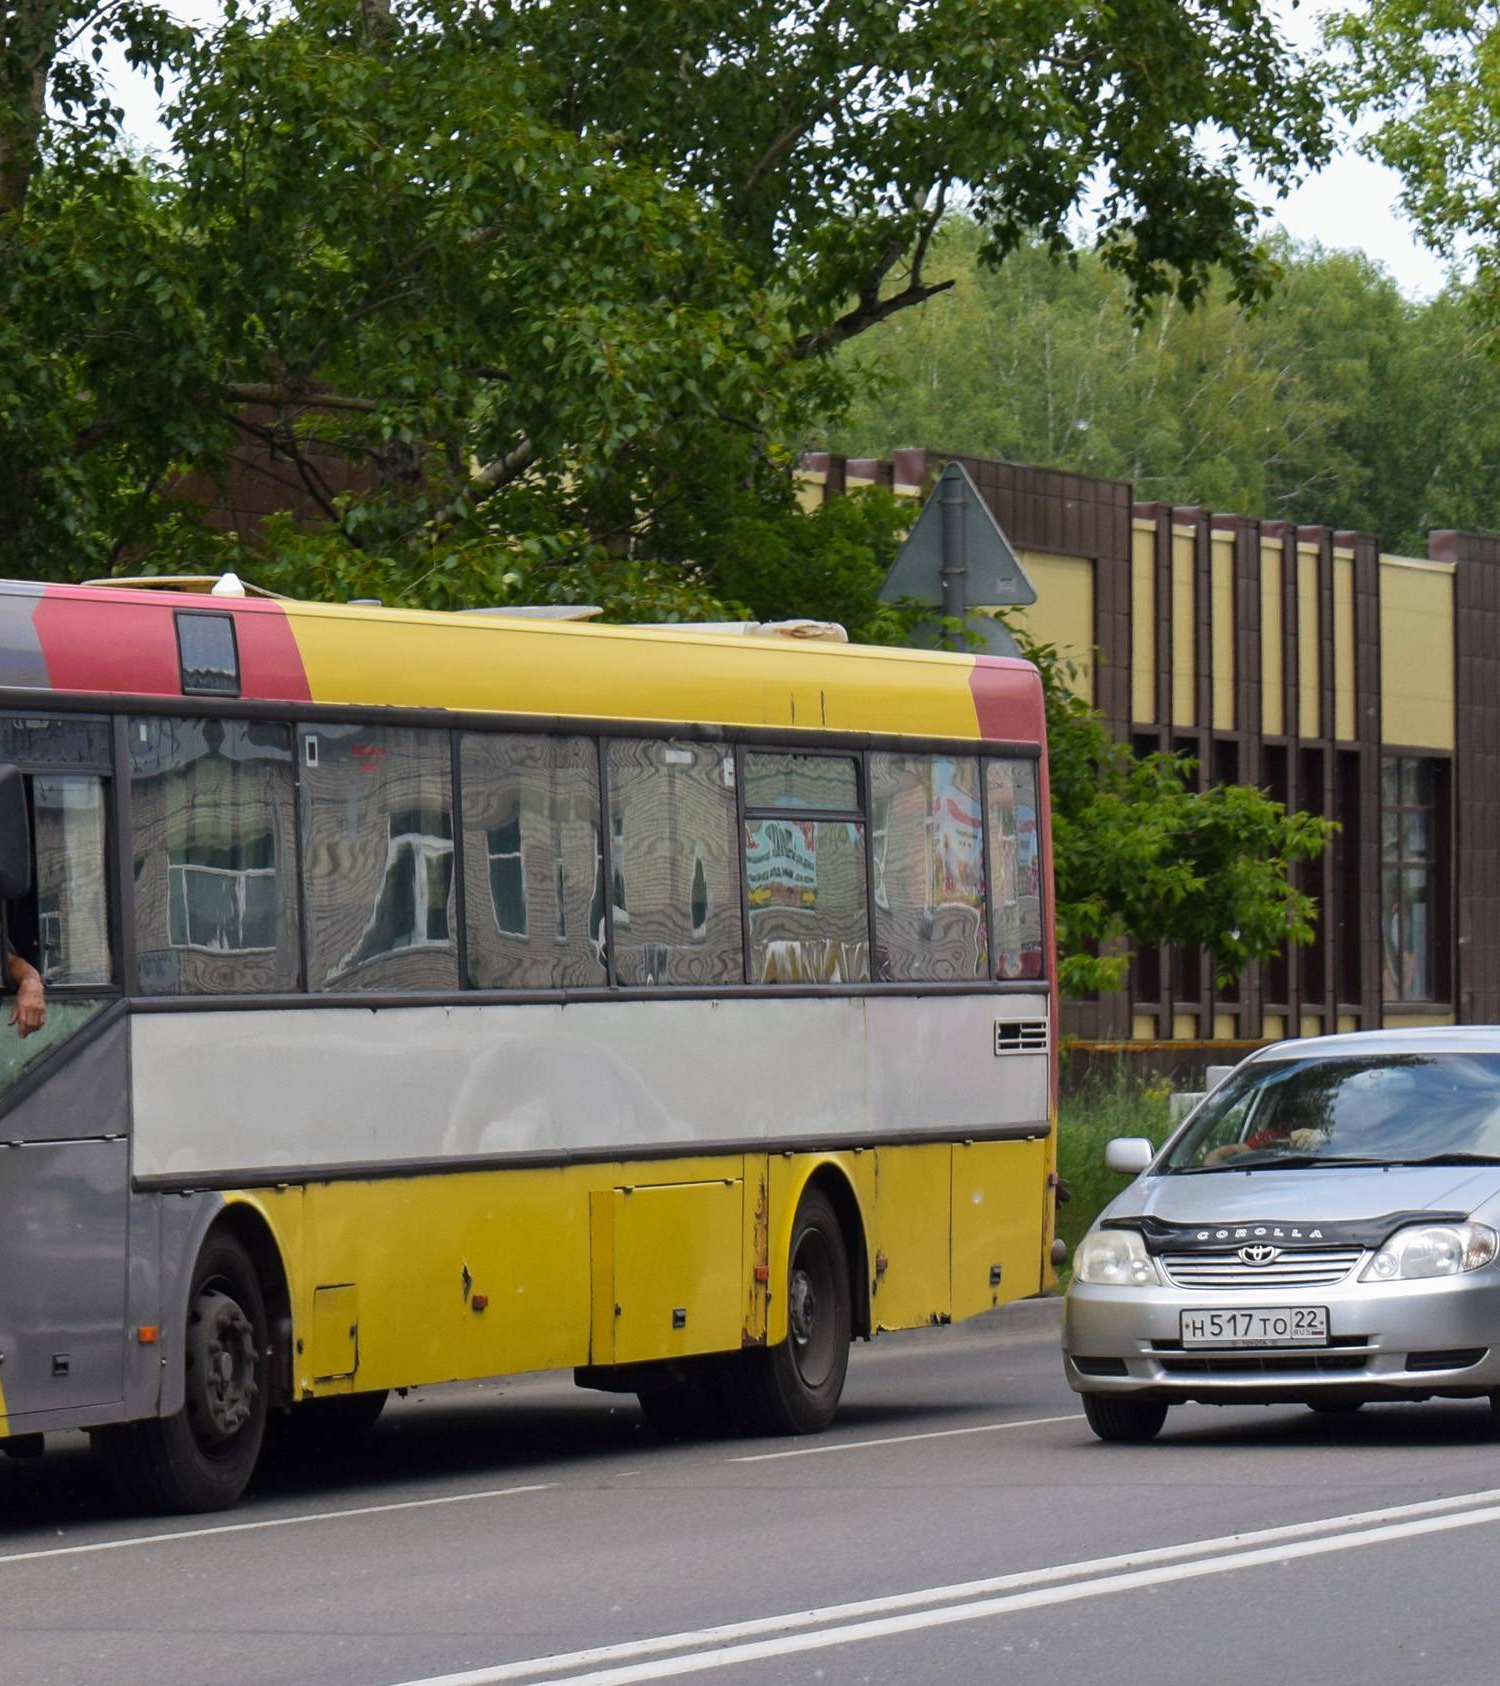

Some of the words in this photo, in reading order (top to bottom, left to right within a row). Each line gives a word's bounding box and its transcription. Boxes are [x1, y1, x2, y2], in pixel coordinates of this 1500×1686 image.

[1197, 1227, 1323, 1241] COROLLA
[1294, 1310, 1318, 1328] 22
[1293, 1328, 1311, 1336] RUS
